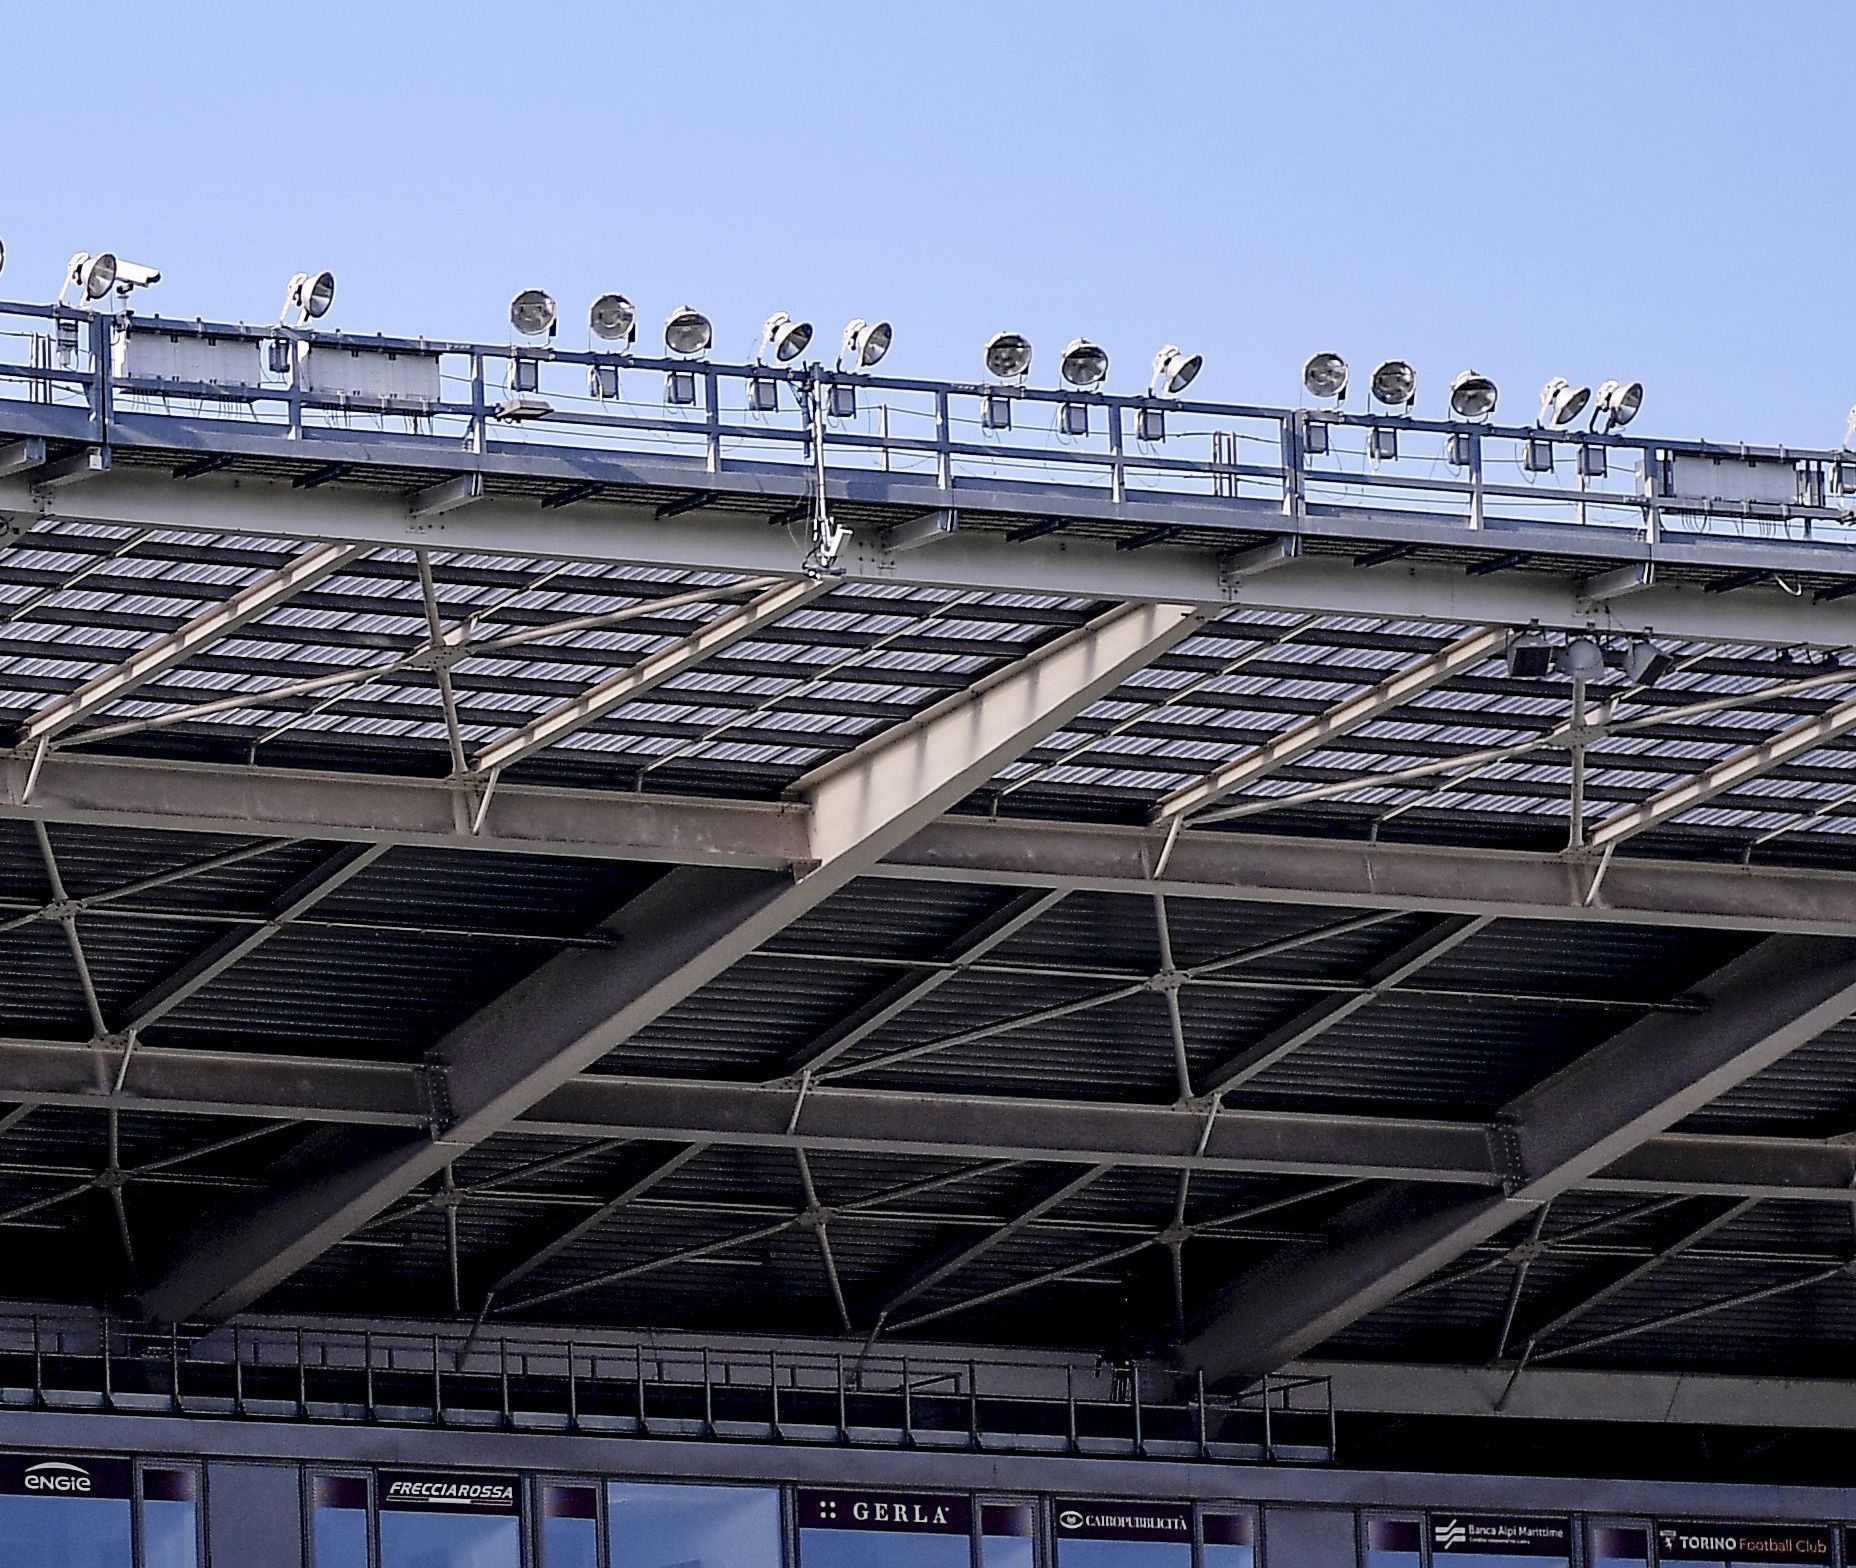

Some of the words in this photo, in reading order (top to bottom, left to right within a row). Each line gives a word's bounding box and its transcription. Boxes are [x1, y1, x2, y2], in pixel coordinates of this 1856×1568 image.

[389, 1480, 514, 1501] FRECCIAROSSA
[853, 1501, 945, 1526] GERLA
[1467, 1524, 1496, 1538] Banca
[1517, 1525, 1564, 1540] Marittime
[1680, 1535, 1737, 1553] TORINO
[1739, 1537, 1794, 1554] Football
[1796, 1538, 1828, 1555] Club
